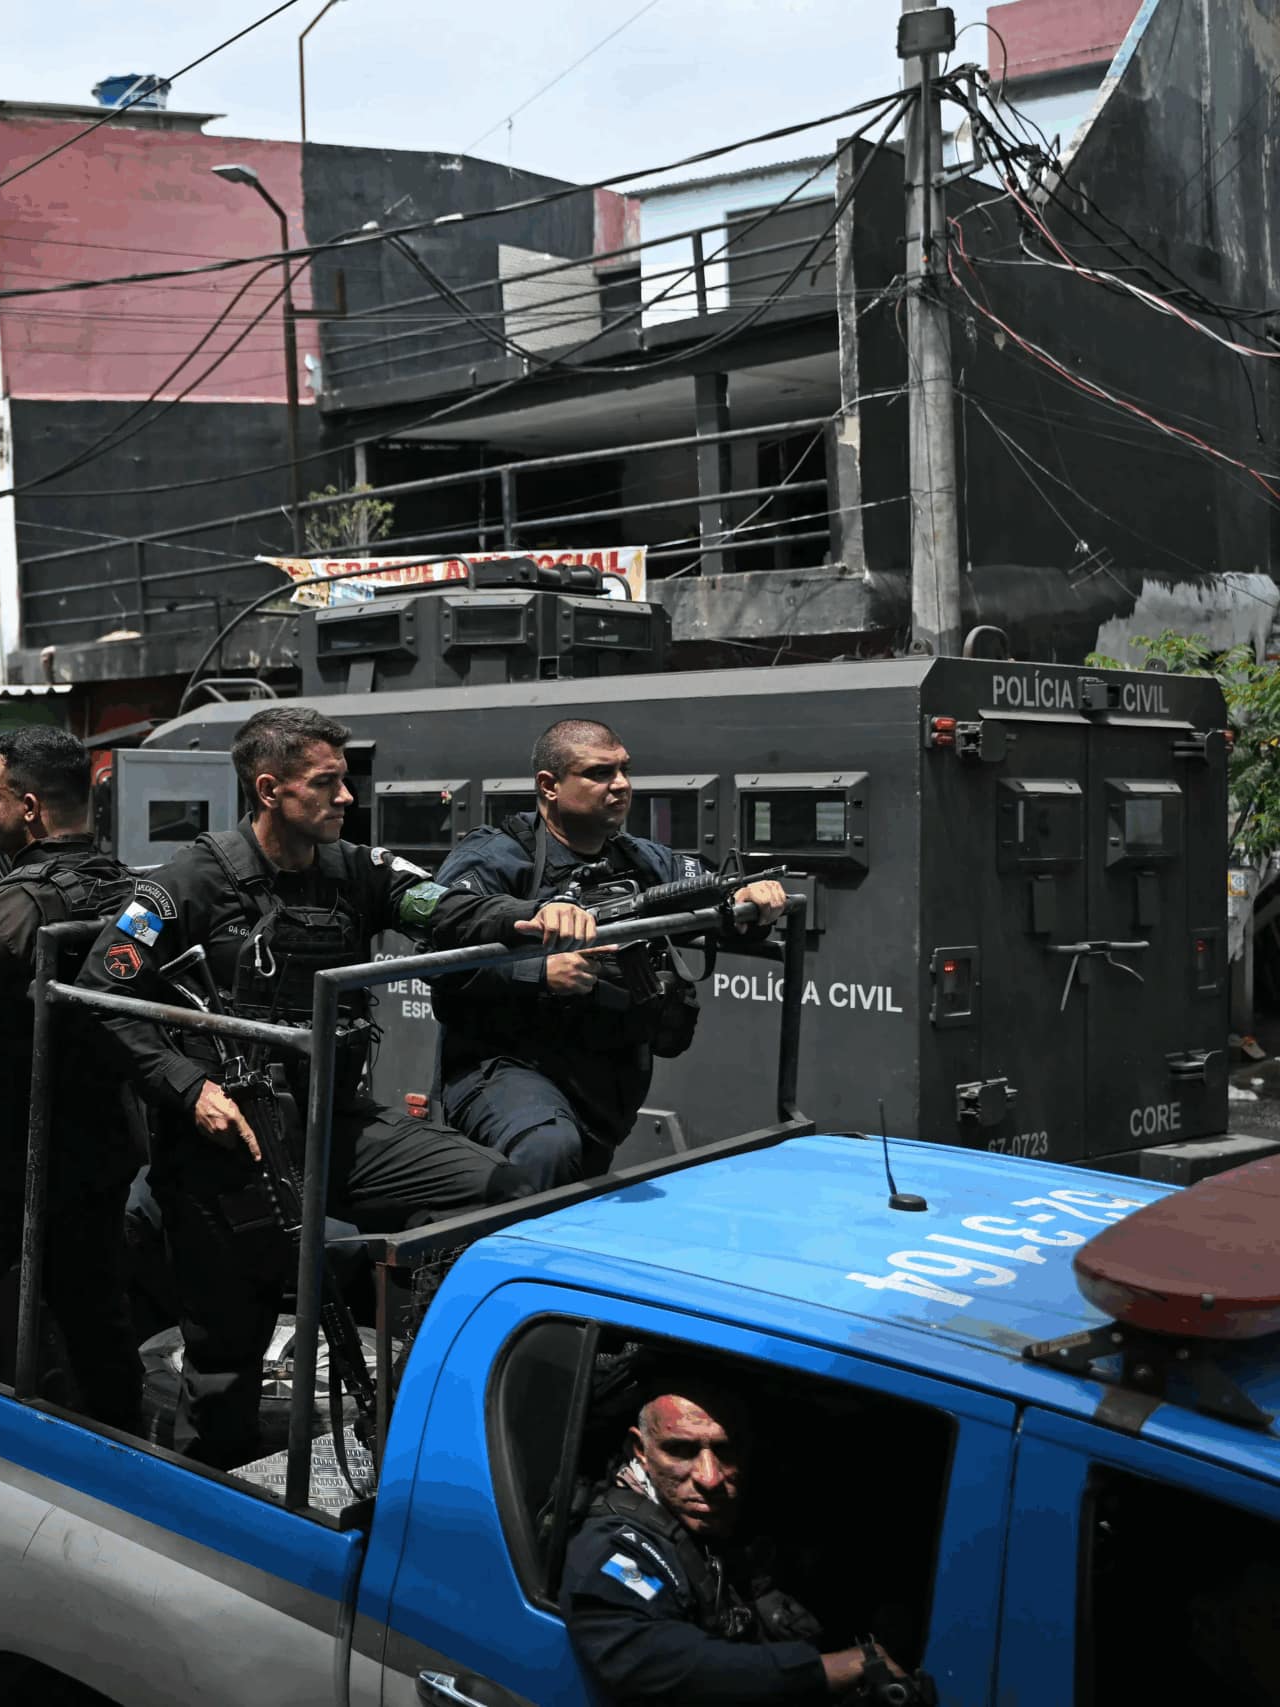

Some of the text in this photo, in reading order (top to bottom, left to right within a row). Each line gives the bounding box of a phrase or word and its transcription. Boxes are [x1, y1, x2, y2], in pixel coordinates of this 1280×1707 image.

[525, 551, 627, 575] OCIAL
[992, 670, 1169, 713] POLÍCIA CIVIL
[388, 979, 408, 994] DE
[713, 971, 903, 1013] POLÍCA CIVIL
[1129, 1102, 1182, 1138] CORE
